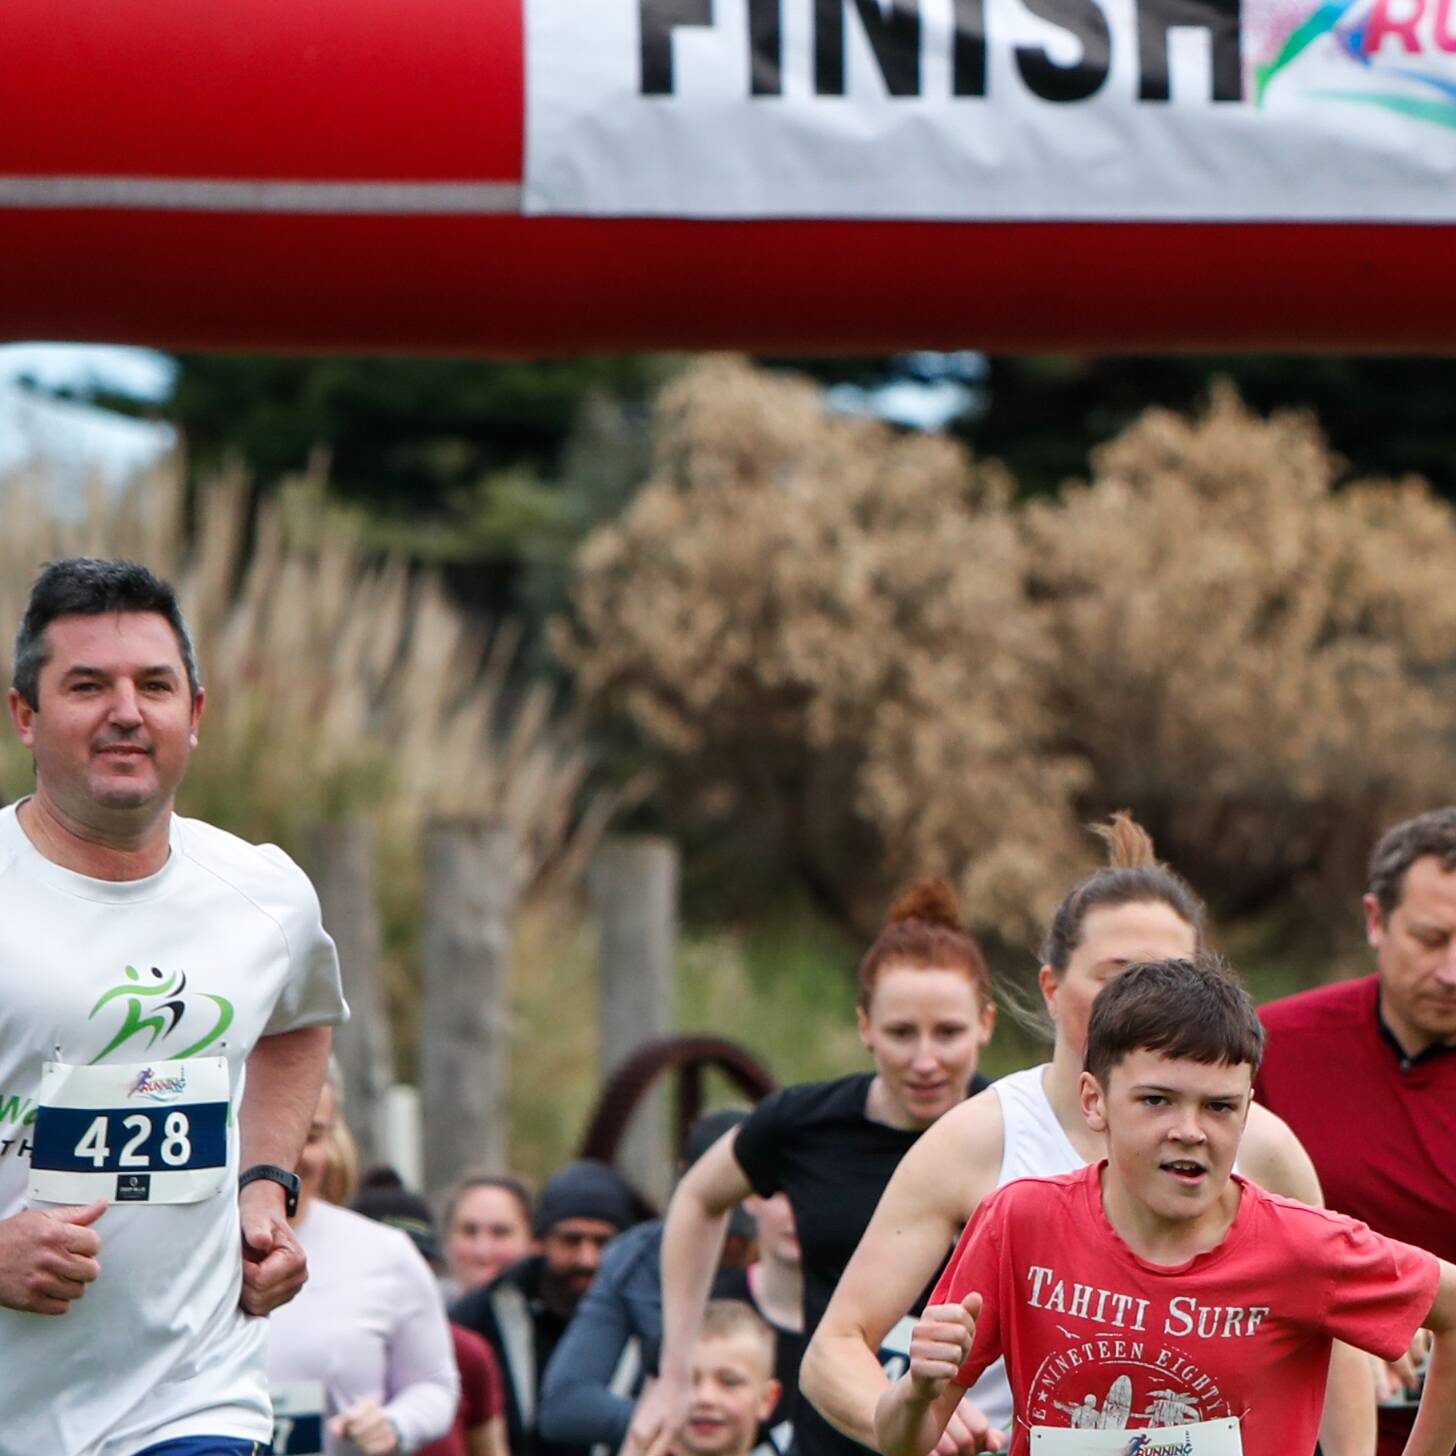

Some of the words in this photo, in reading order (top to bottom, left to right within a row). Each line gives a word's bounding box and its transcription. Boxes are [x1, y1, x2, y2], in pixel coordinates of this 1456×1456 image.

[640, 0, 1245, 103] FINISH
[74, 1111, 192, 1167] 428
[1027, 1266, 1150, 1332] TAHITI
[1164, 1297, 1270, 1339] SURF
[1042, 1341, 1144, 1389] NINETEEN
[1156, 1349, 1224, 1412] EIGHTY
